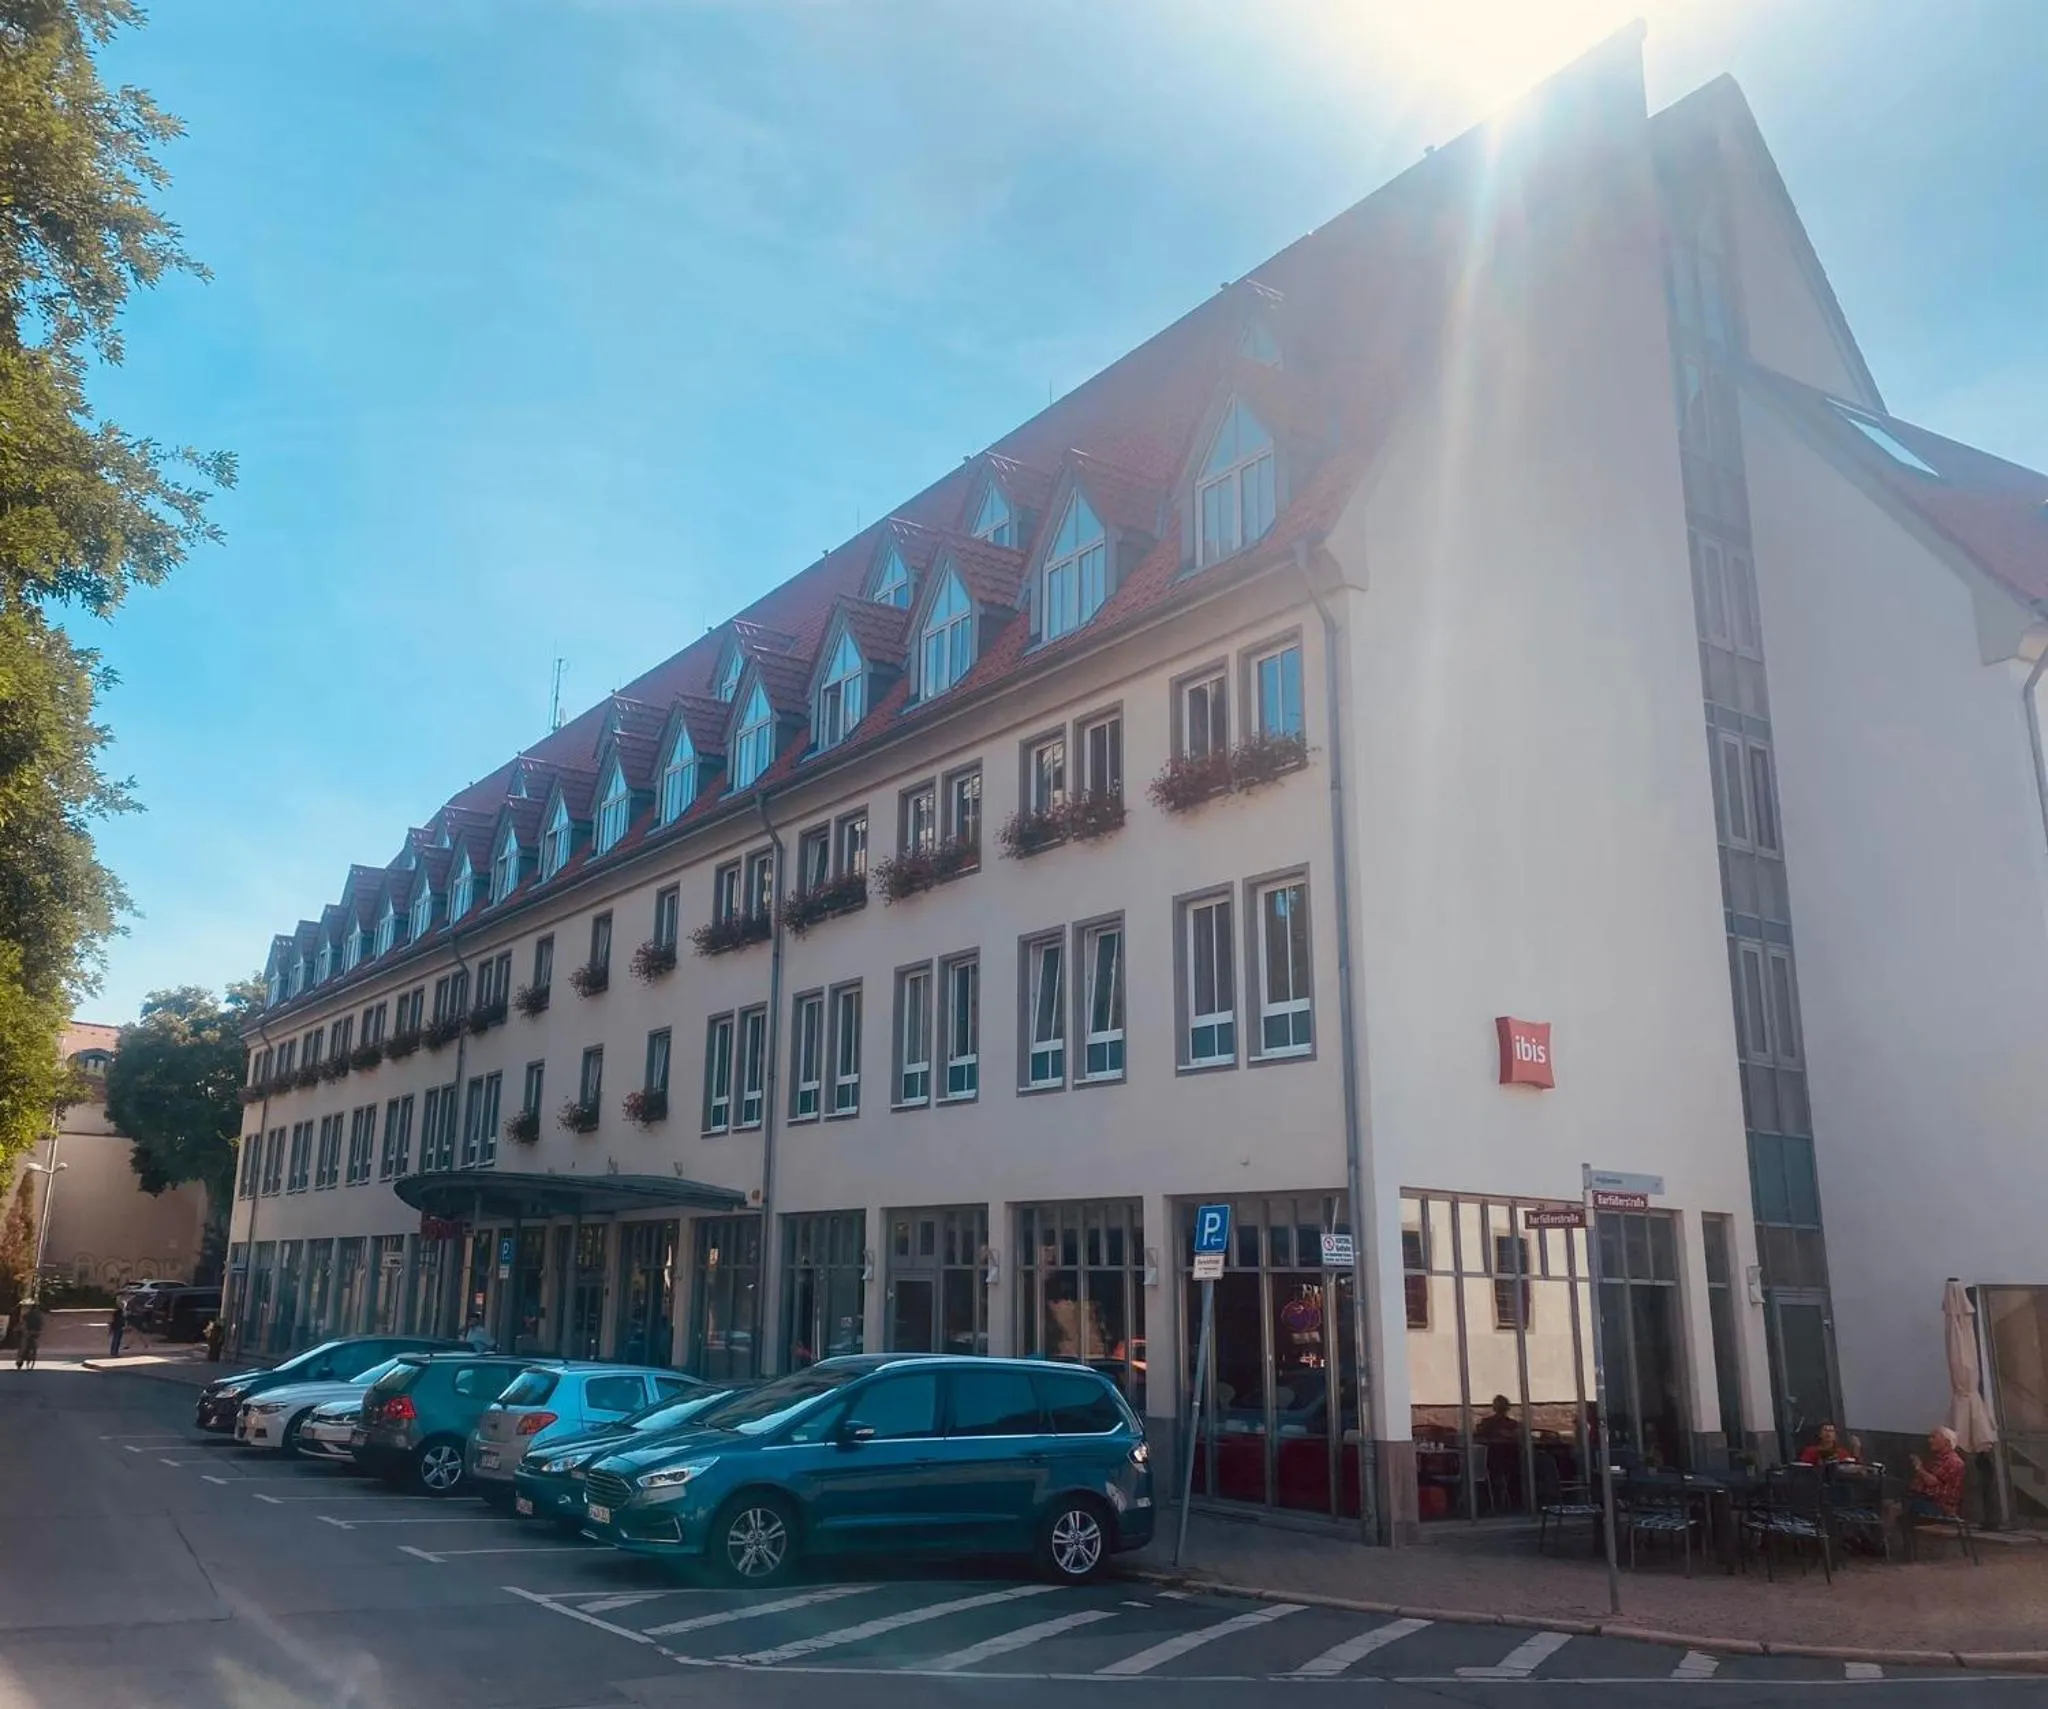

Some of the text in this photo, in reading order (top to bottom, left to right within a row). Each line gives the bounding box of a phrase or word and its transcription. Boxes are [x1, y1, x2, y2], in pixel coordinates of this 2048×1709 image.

[1514, 1035, 1546, 1063] ibis
[1202, 1212, 1221, 1246] P
[502, 1241, 510, 1260] P
